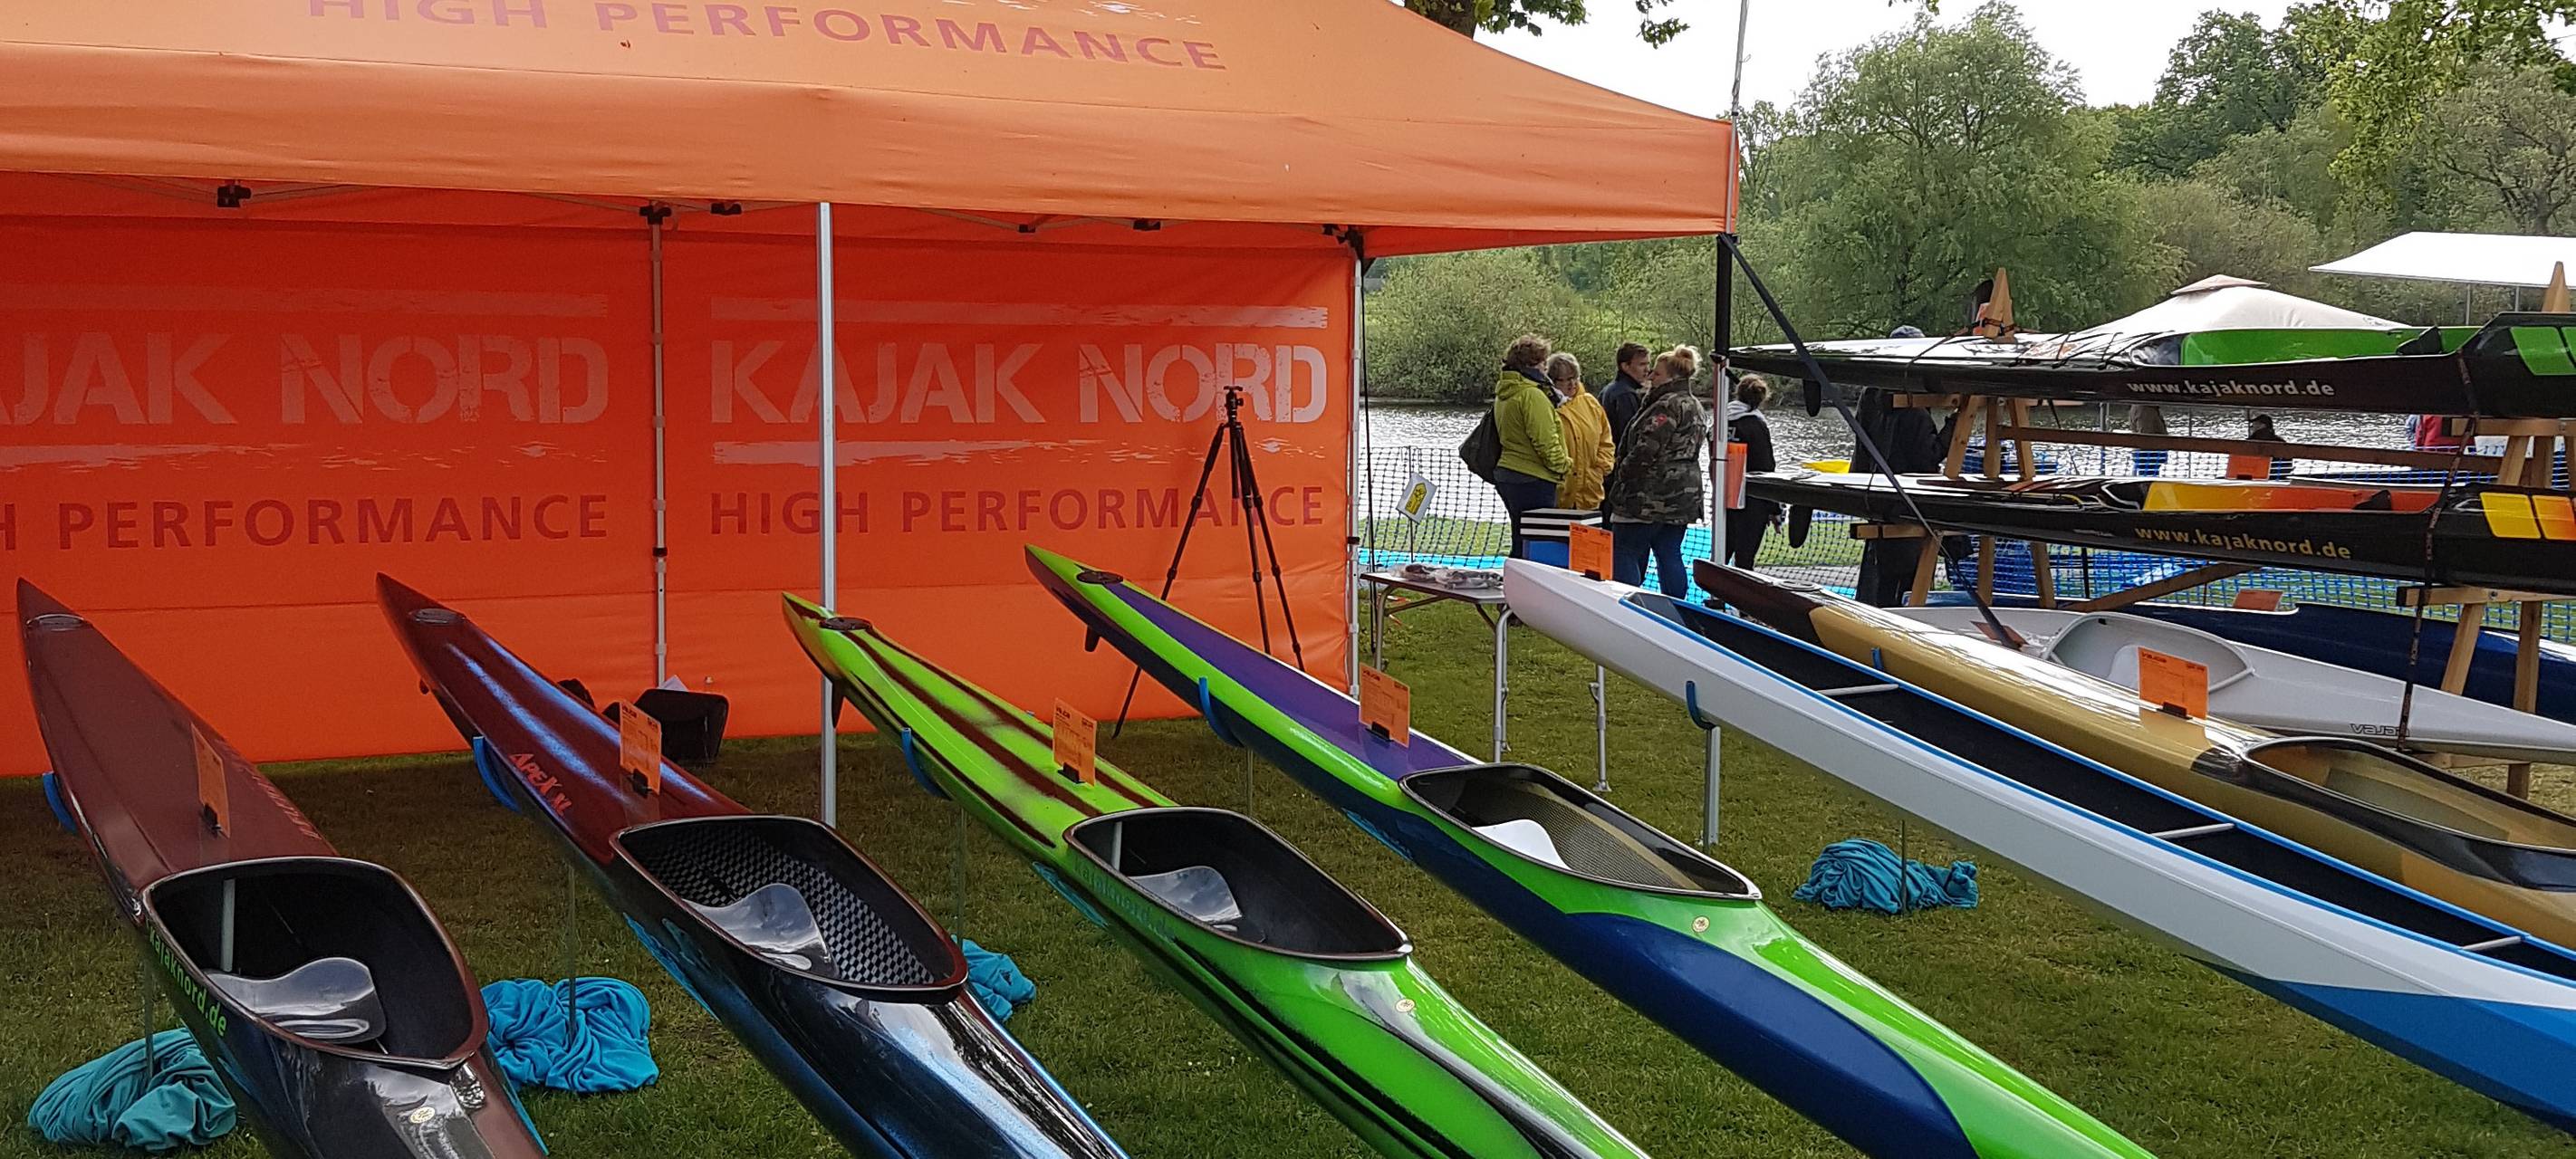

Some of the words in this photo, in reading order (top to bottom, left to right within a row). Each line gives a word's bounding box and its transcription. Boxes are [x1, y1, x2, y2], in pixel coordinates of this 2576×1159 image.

[310, 0, 547, 28] HIGH
[594, 3, 1226, 70] PERFORMANCE
[0, 331, 237, 425] JAK
[282, 333, 609, 425] NORD
[711, 340, 1046, 424] KAJAK
[1079, 343, 1327, 423] NORD
[2128, 380, 2335, 397] www.kajaknord.de
[59, 494, 608, 550] PERFORMANCE
[711, 492, 869, 534] HIGH
[2135, 527, 2352, 559] www.kajaknord.de
